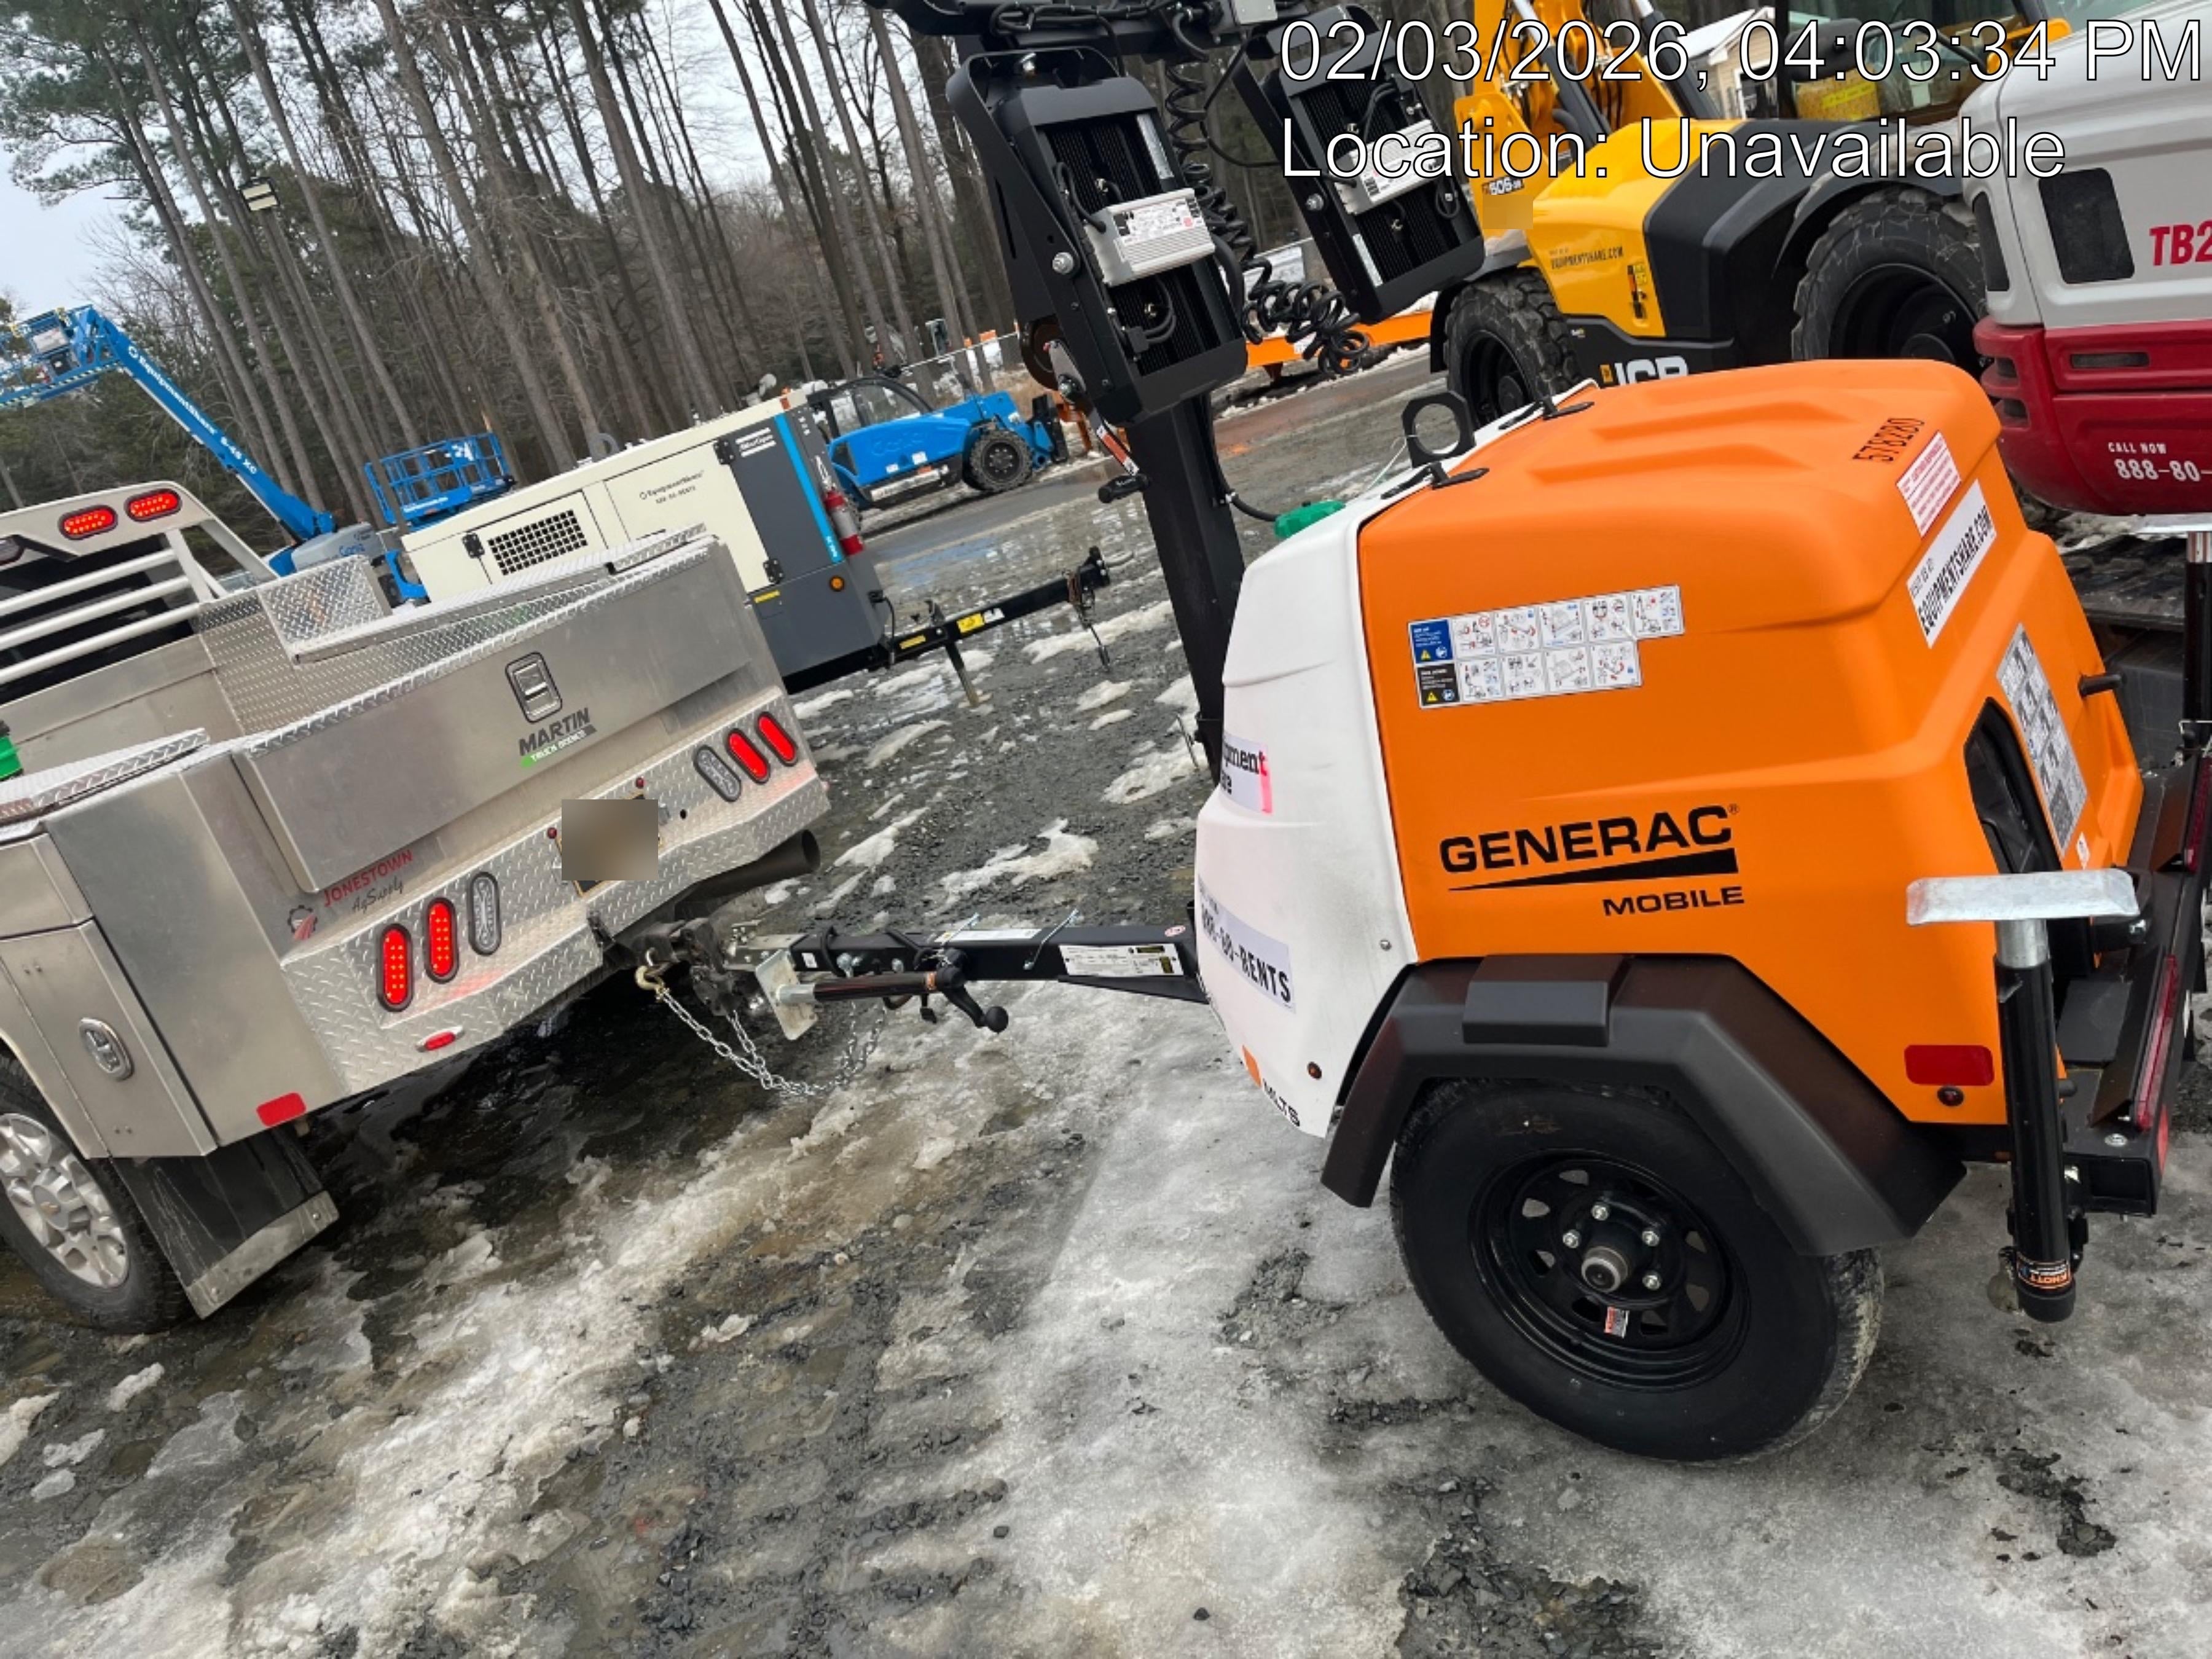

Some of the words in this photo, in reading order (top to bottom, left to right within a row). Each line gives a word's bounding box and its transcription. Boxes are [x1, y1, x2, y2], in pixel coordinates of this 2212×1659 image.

[2108, 442, 2137, 453] CALL
[2139, 442, 2167, 454] NOW
[519, 707, 590, 756] MARTIN
[324, 849, 414, 908] JONESTOWN
[1602, 886, 1745, 917] MOBILE
